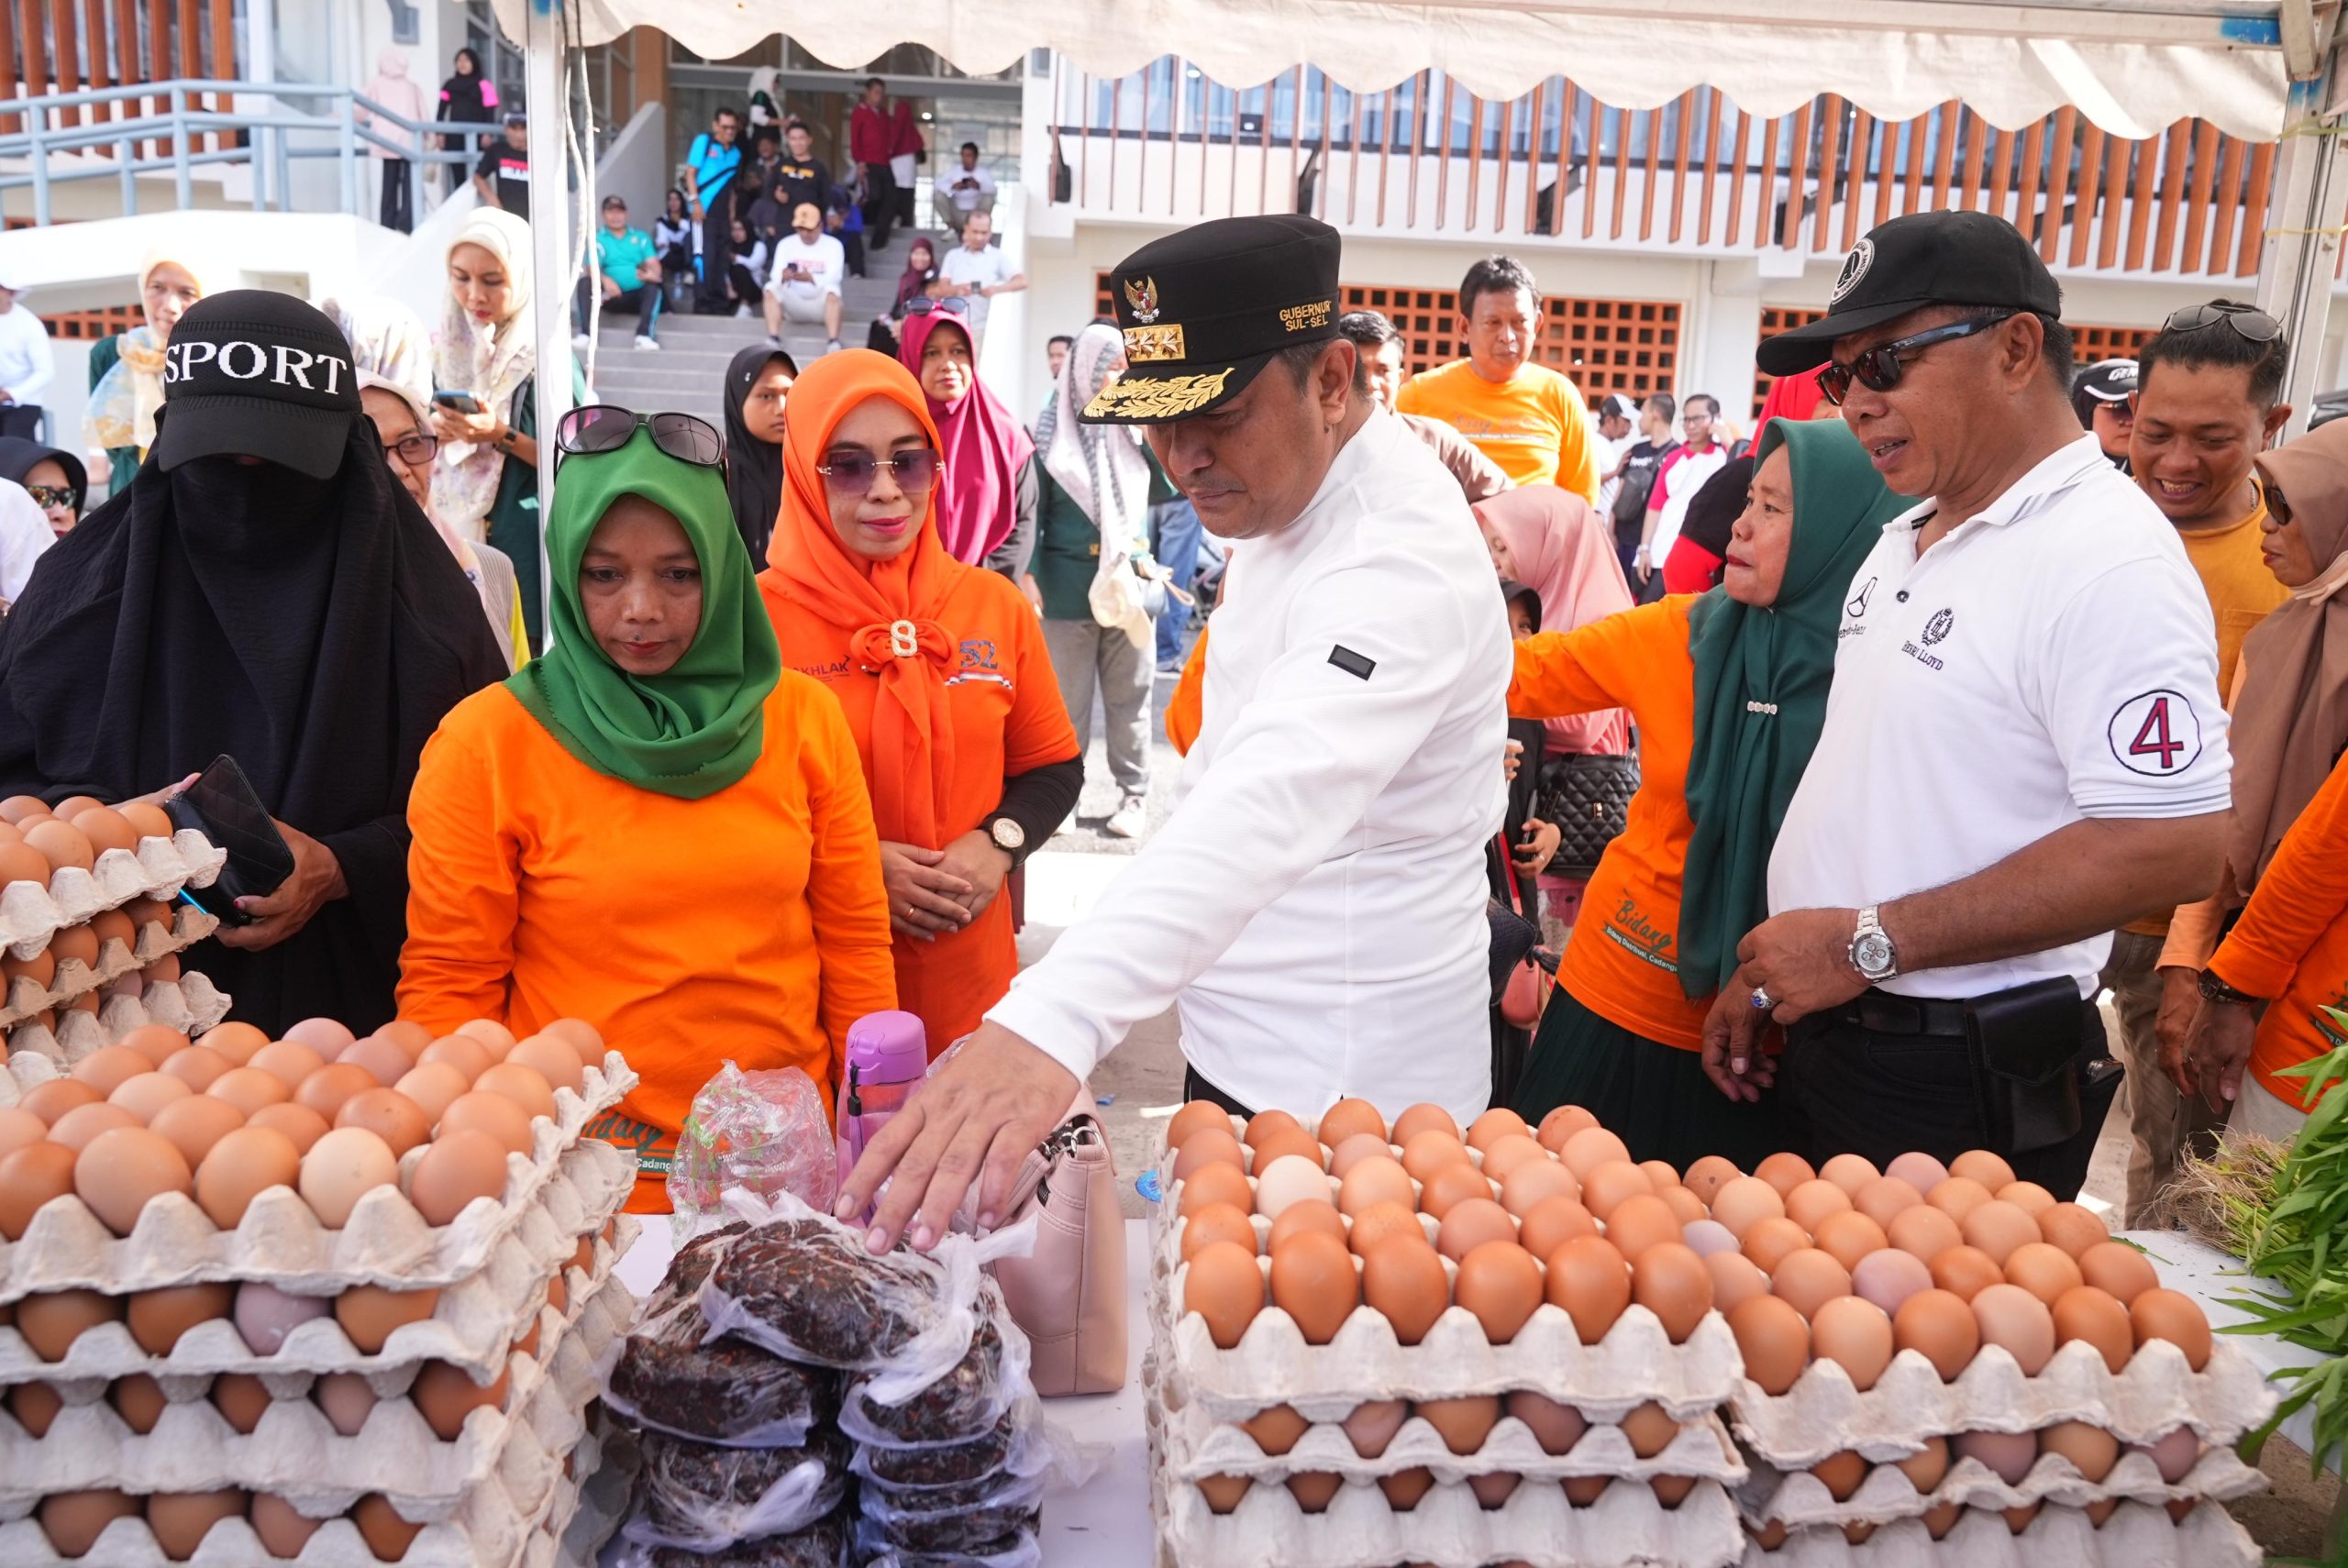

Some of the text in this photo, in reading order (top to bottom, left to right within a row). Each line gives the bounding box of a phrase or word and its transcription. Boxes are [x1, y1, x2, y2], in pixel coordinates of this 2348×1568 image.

[1278, 300, 1332, 321] GUBERNUR
[1285, 315, 1328, 332] SUL-SEL
[165, 341, 348, 394] SPORT
[792, 662, 849, 676] KHLAK
[958, 640, 998, 669] 52
[1917, 648, 1944, 671] LLOYD
[2129, 697, 2184, 768] 4
[1615, 900, 1673, 953] Bidang
[580, 1109, 665, 1154] idang
